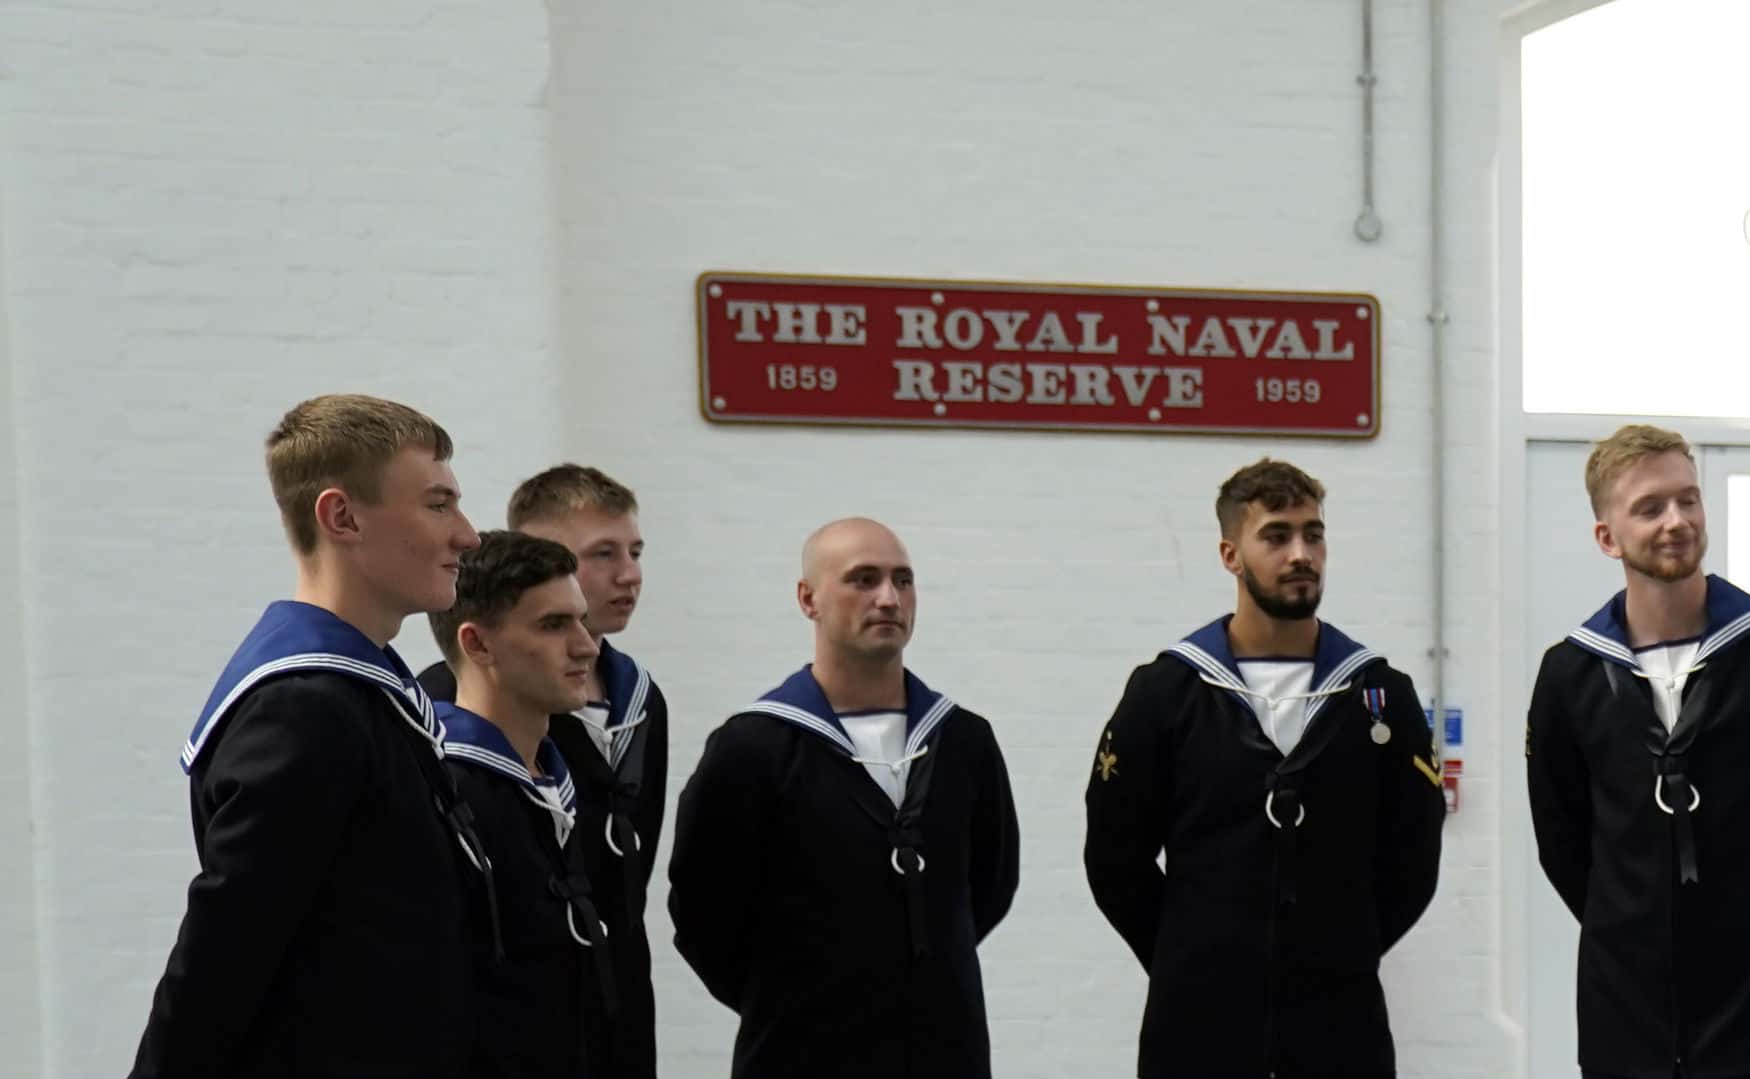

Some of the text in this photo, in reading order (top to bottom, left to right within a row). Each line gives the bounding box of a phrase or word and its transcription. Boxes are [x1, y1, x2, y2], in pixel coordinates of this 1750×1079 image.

[726, 301, 1354, 360] THE ROYAL NAVAL
[766, 366, 837, 390] 1859
[893, 360, 1203, 407] RESERVE
[1255, 379, 1321, 403] 1959
